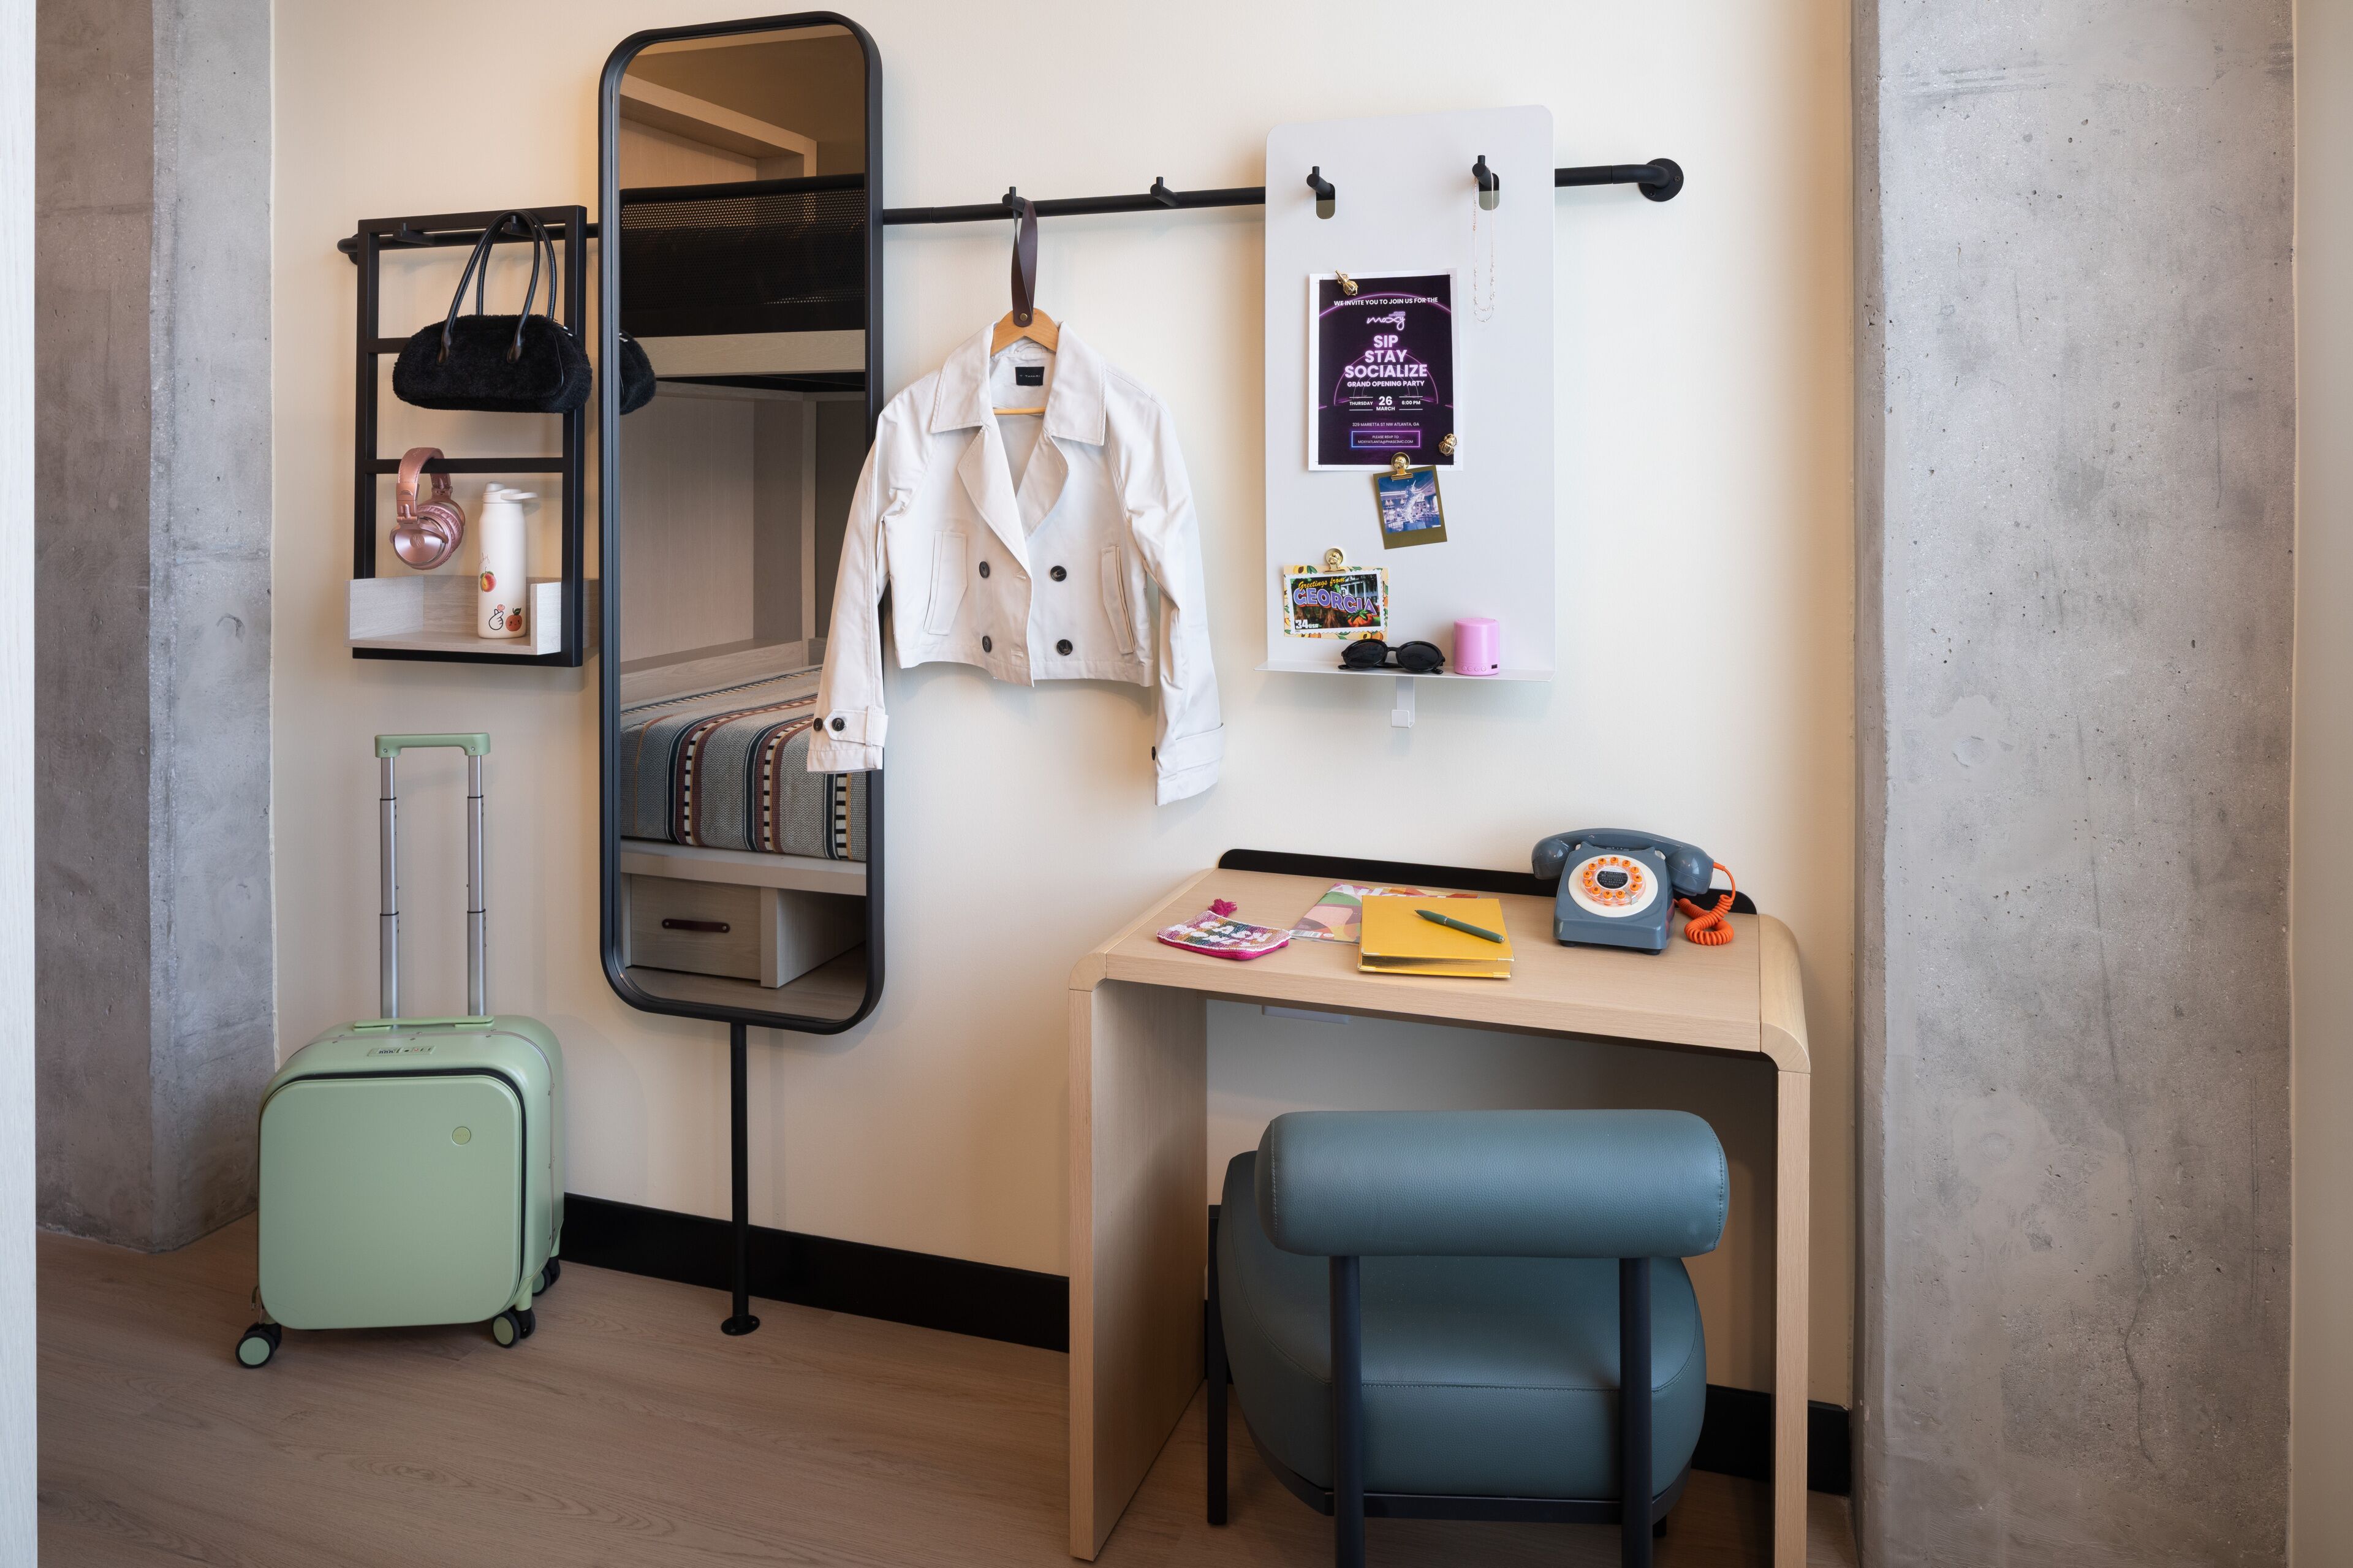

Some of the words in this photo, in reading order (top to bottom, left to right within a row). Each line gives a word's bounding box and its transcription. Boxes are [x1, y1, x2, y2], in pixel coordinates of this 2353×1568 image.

[1373, 335, 1398, 348] SIP
[1365, 349, 1408, 363] STAY
[1344, 364, 1428, 378] SOCIALIZE
[1379, 396, 1393, 406] 26
[1298, 581, 1328, 590] Greetings
[1330, 577, 1346, 586] from
[1293, 588, 1378, 615] GEORGIA
[1295, 619, 1308, 629] 34
